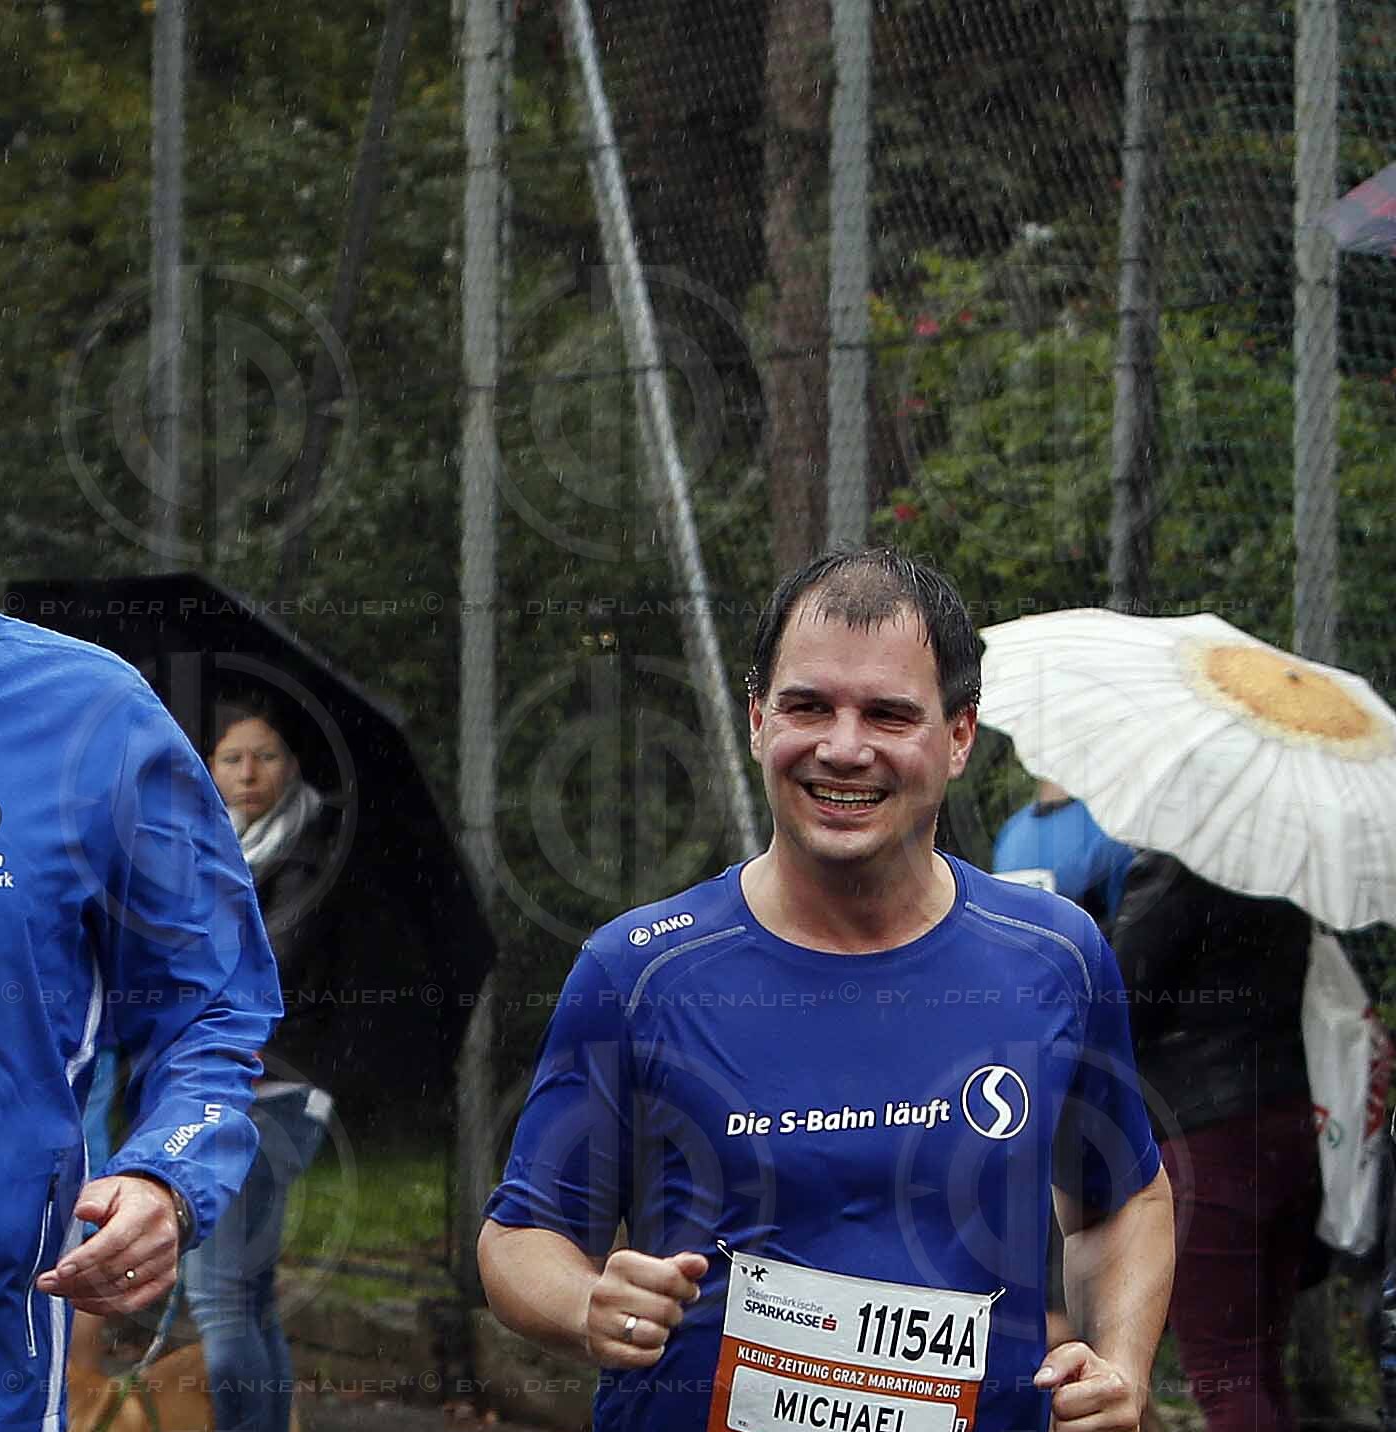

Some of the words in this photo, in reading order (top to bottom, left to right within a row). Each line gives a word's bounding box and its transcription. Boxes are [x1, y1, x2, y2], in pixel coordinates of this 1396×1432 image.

[651, 913, 695, 936] JAKO
[726, 1112, 772, 1136] Die
[779, 1106, 875, 1134] S-Bahn
[885, 1100, 951, 1128] läuft
[743, 1299, 822, 1329] SPARKASSE
[857, 1302, 976, 1368] 11154A
[738, 1346, 775, 1368] KLEINE
[778, 1356, 829, 1380] ZEITUNG
[833, 1367, 866, 1386] GRAZ
[868, 1375, 933, 1396] MARATHON
[935, 1383, 961, 1398] 2015
